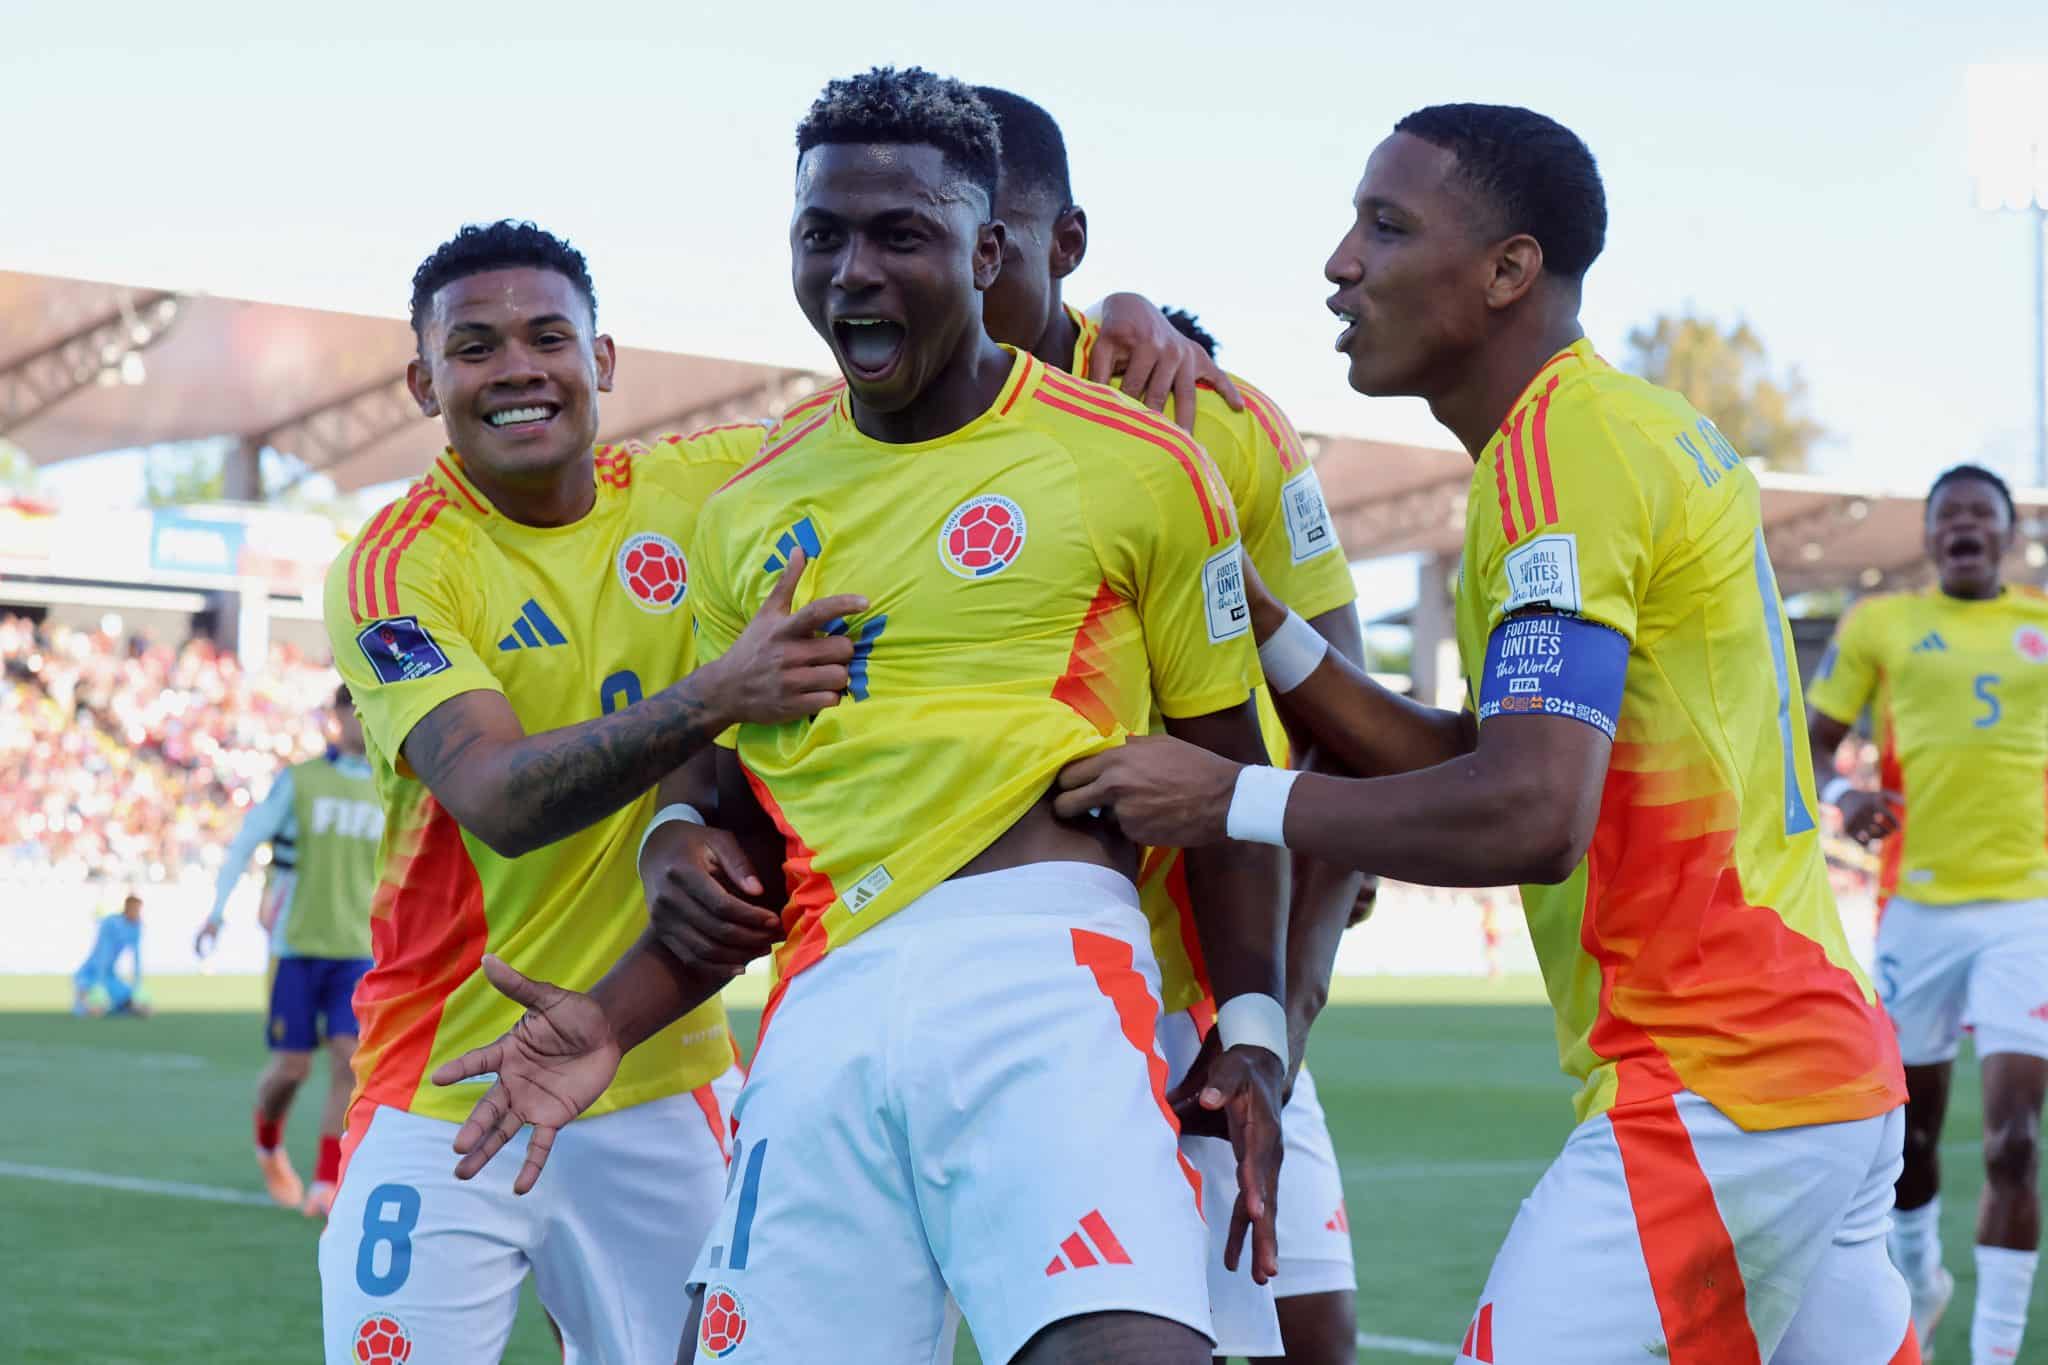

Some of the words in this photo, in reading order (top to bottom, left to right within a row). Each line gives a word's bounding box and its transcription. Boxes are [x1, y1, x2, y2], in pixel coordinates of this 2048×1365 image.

[1528, 581, 1563, 598] World
[1505, 619, 1562, 638] FOOTBALL
[1501, 635, 1560, 658] UNITES
[1496, 660, 1515, 678] the
[1517, 656, 1564, 677] World
[1510, 679, 1538, 692] FIFA
[1973, 674, 2004, 728] 5
[355, 1183, 422, 1297] 8
